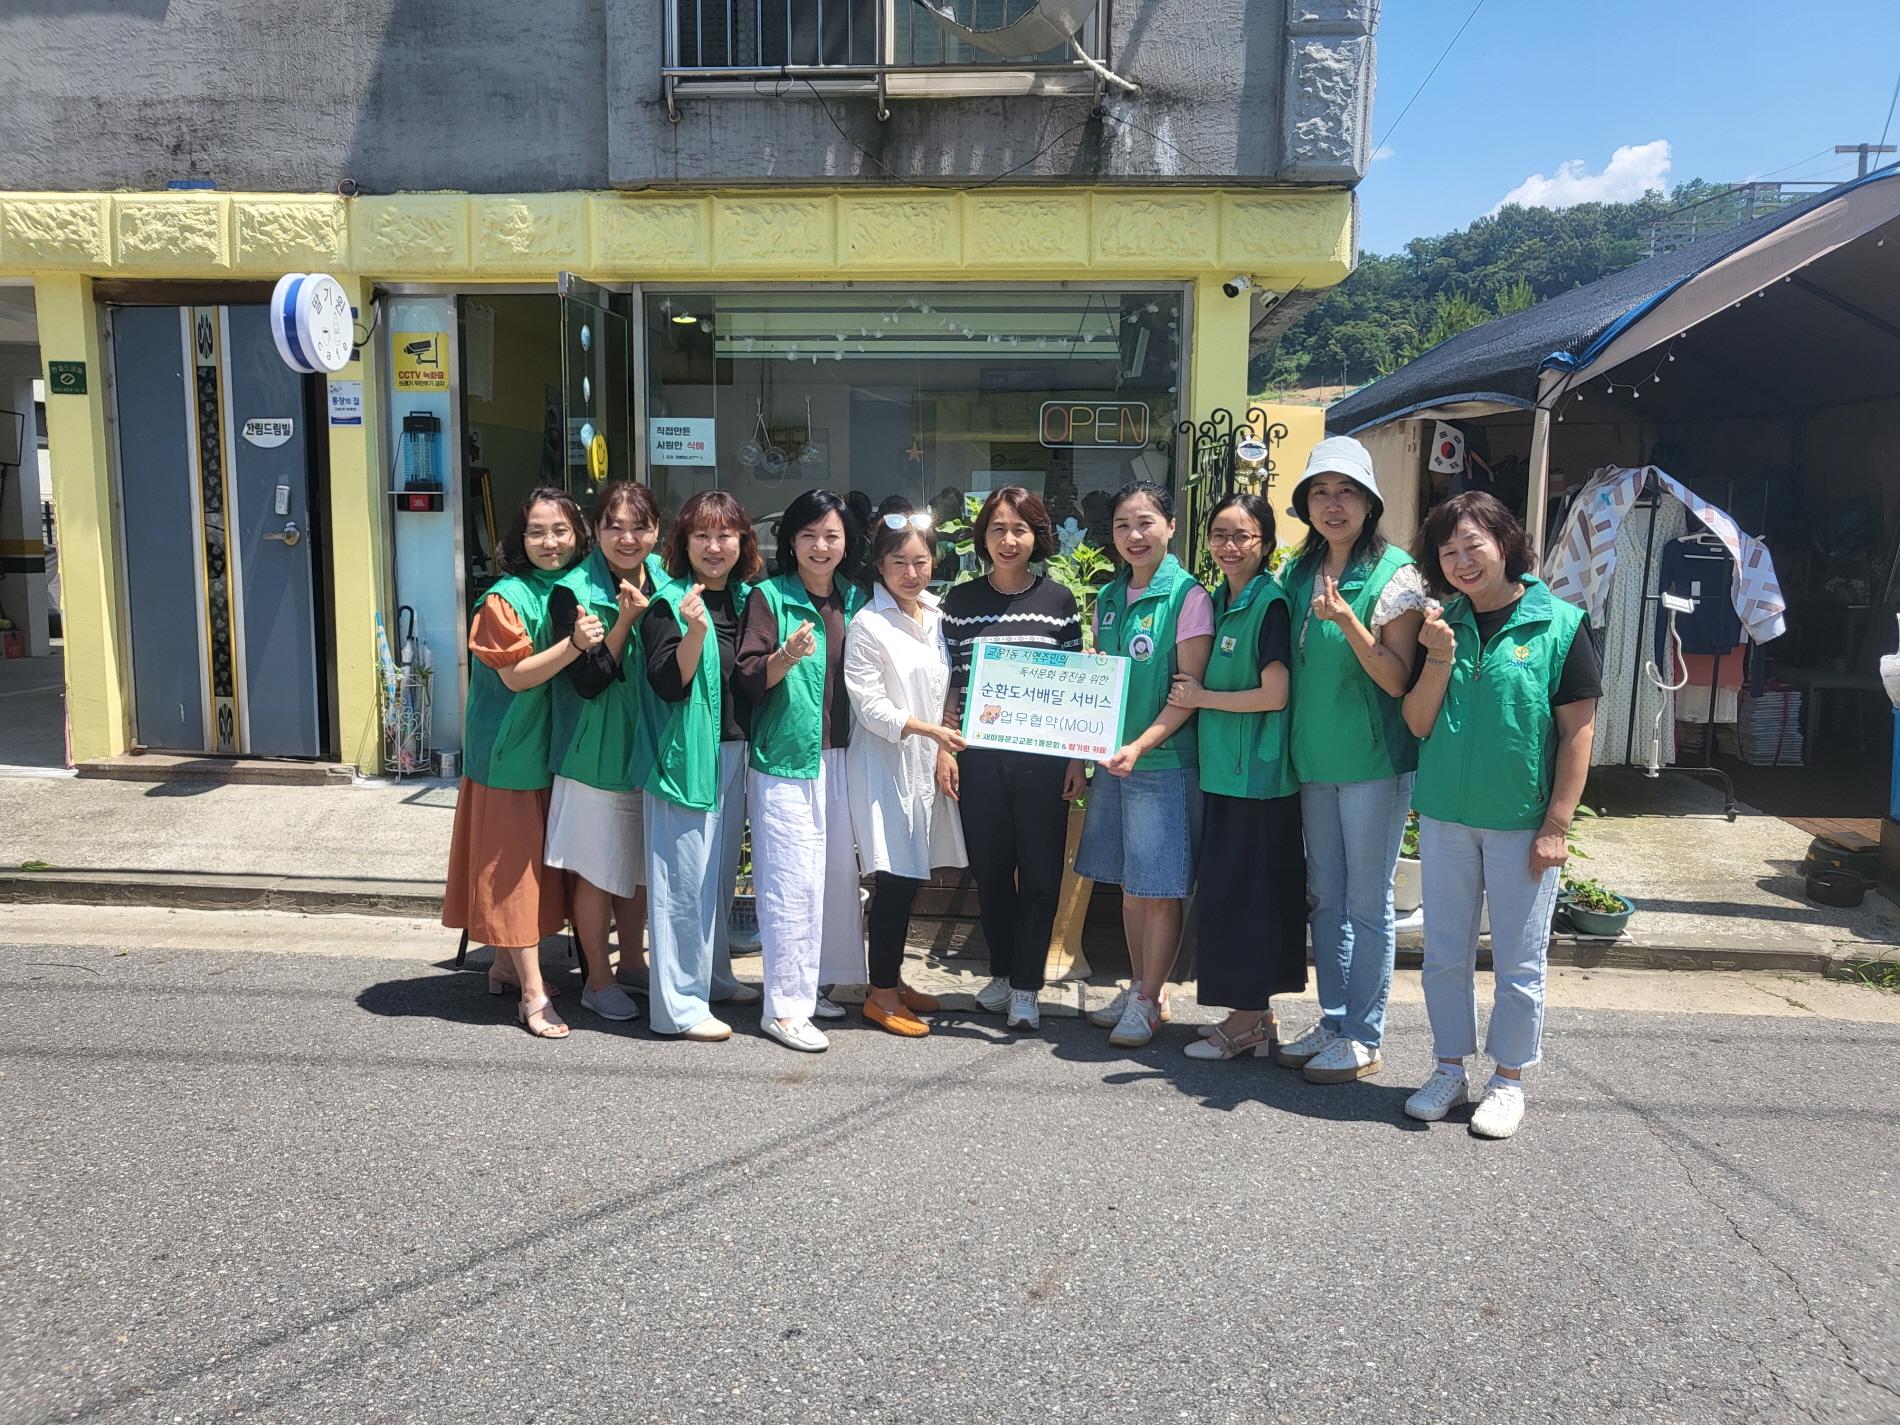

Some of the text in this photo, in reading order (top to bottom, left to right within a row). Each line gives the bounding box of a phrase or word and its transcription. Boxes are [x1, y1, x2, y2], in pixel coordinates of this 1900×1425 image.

[312, 286, 346, 317] 딸기원
[398, 370, 421, 380] CCTV
[353, 397, 360, 406] 집
[656, 427, 690, 436] 직접만든
[1044, 406, 1146, 443] OPEN
[656, 441, 682, 450] 시원한
[987, 647, 1069, 665] 교문1동 지역주민의
[1020, 666, 1109, 686] 독서문화 증진을 위한
[981, 682, 1112, 709] 순환도서배달 서비스
[1000, 710, 1104, 735] 업무협약(MOU)
[1068, 743, 1090, 753] 딸기원
[1092, 746, 1107, 755] 카페
